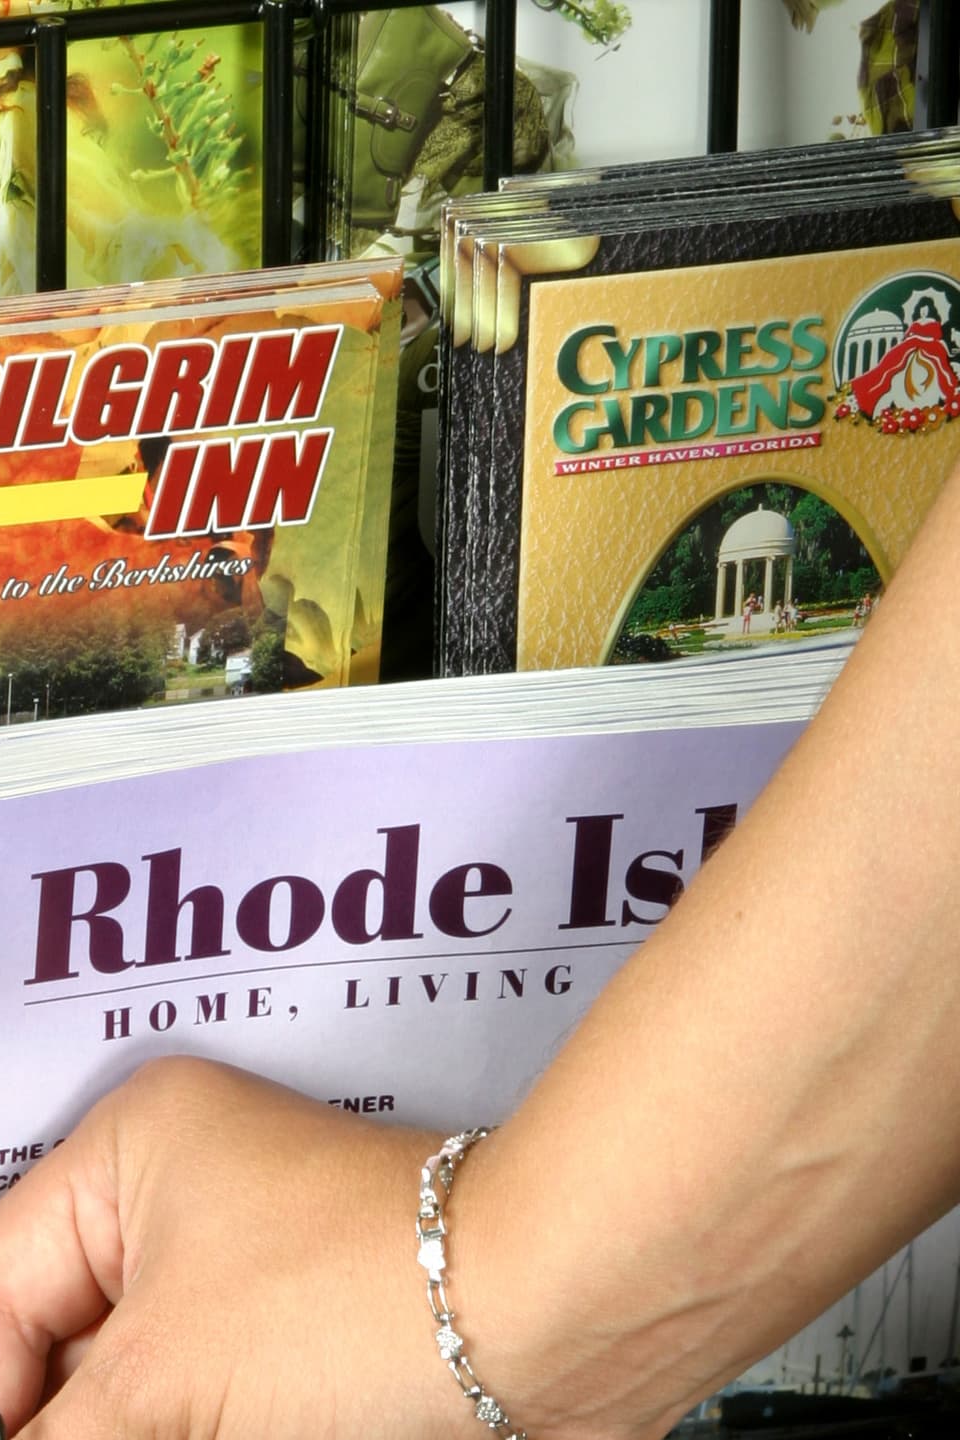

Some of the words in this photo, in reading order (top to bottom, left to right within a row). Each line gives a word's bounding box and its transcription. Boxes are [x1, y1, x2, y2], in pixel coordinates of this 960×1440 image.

[557, 317, 828, 396] CYPRESS
[553, 375, 827, 454] GARDENS
[145, 427, 334, 541] INN
[561, 455, 641, 474] WINTER
[647, 446, 722, 466] HAVEN,
[726, 435, 817, 456] FLORIDA
[1, 575, 30, 599] to
[39, 565, 84, 596] the
[89, 553, 252, 592] Berkshires
[22, 822, 515, 986] Rhode
[103, 986, 301, 1042] HOME,
[344, 964, 575, 1010] LIVING
